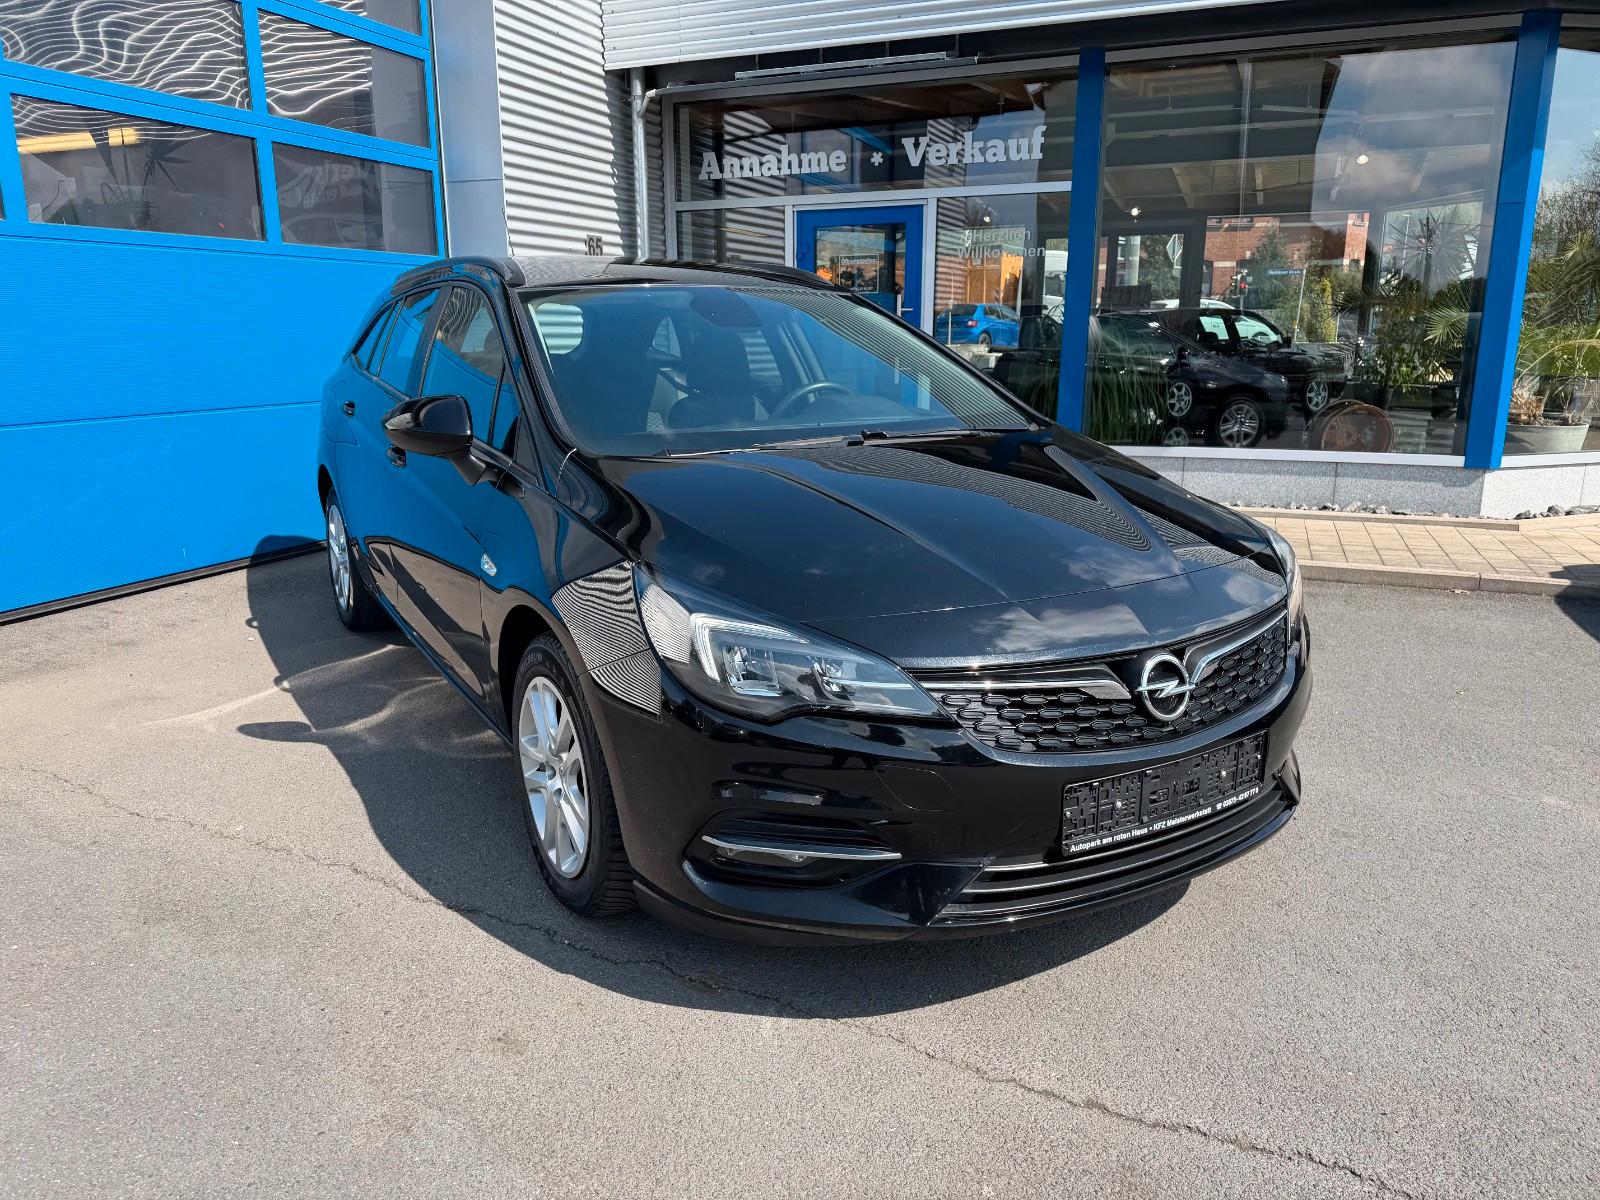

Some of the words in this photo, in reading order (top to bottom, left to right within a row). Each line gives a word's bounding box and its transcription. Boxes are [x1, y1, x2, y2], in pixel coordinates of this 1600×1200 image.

[699, 144, 847, 180] Annahme
[901, 125, 1048, 167] Verkauf
[973, 228, 1031, 243] Herzlich
[957, 245, 1046, 258] Willkoen
[1070, 840, 1101, 852] Autopark
[1131, 828, 1148, 837] Haus
[1153, 821, 1166, 831] KFZ
